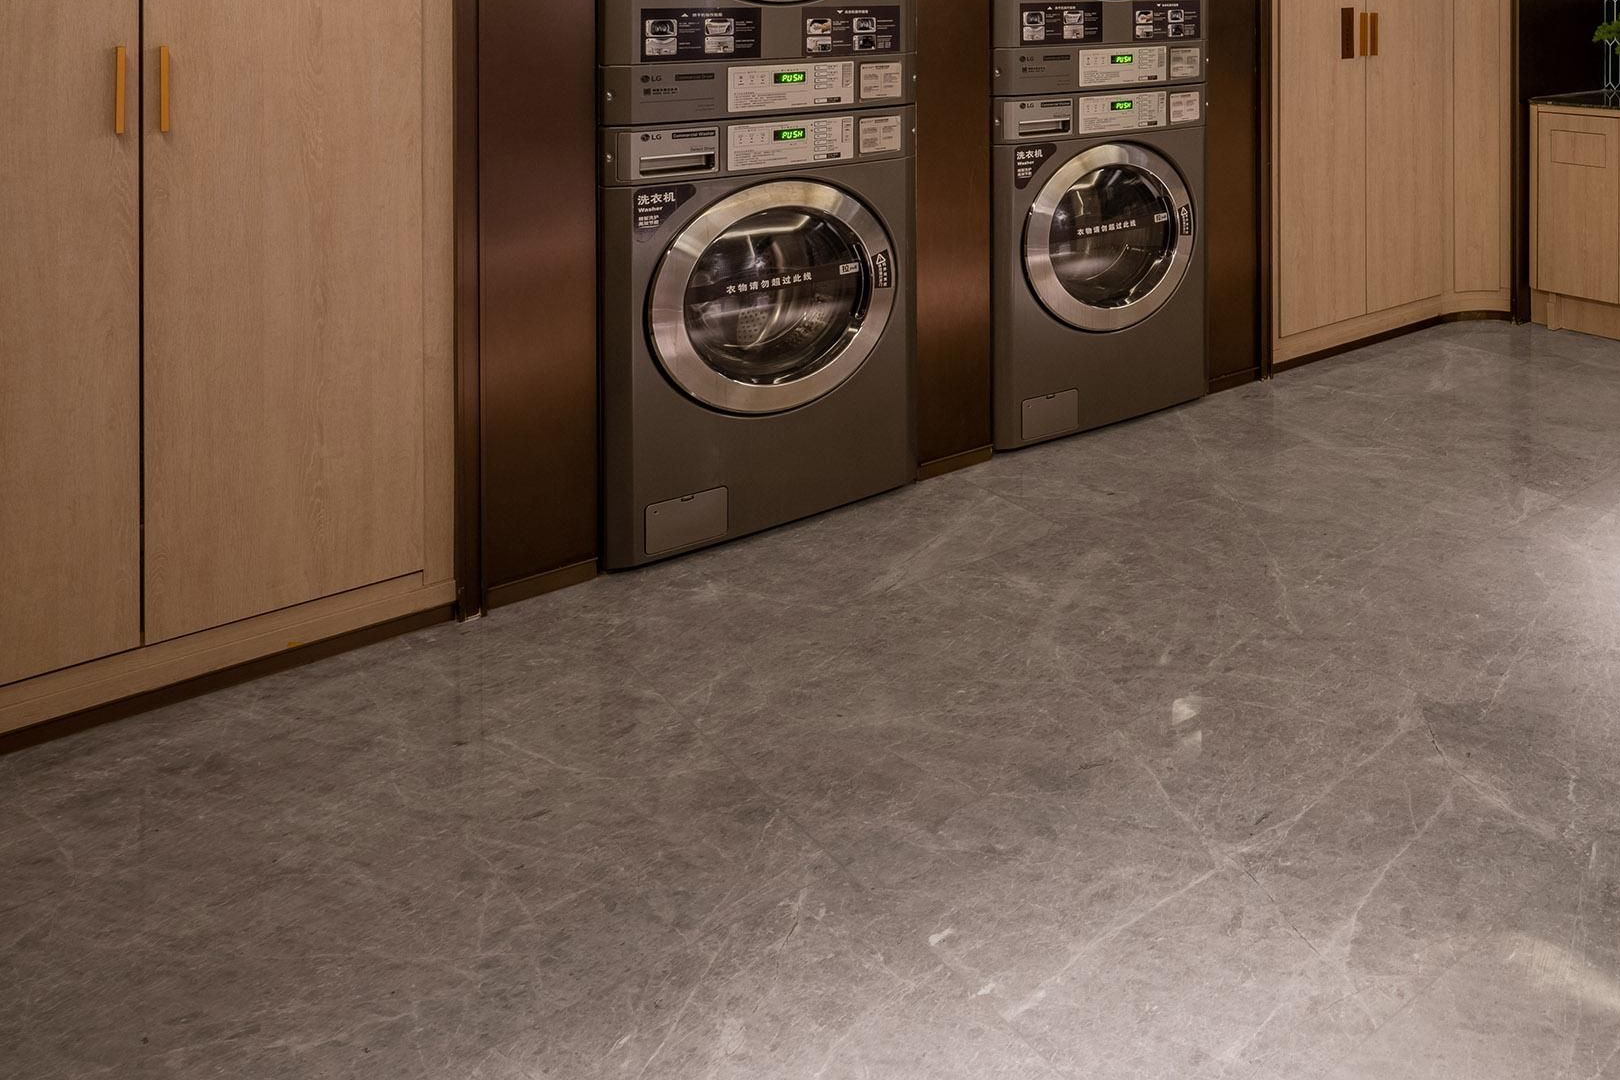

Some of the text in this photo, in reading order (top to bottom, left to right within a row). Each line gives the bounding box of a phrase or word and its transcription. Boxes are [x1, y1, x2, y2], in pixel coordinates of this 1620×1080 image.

[782, 73, 804, 82] PUSH
[782, 130, 804, 139] PUSH
[1016, 149, 1044, 160] 洗衣机
[637, 192, 677, 206] 洗衣机
[725, 271, 813, 294] 衣物请勿超过此线
